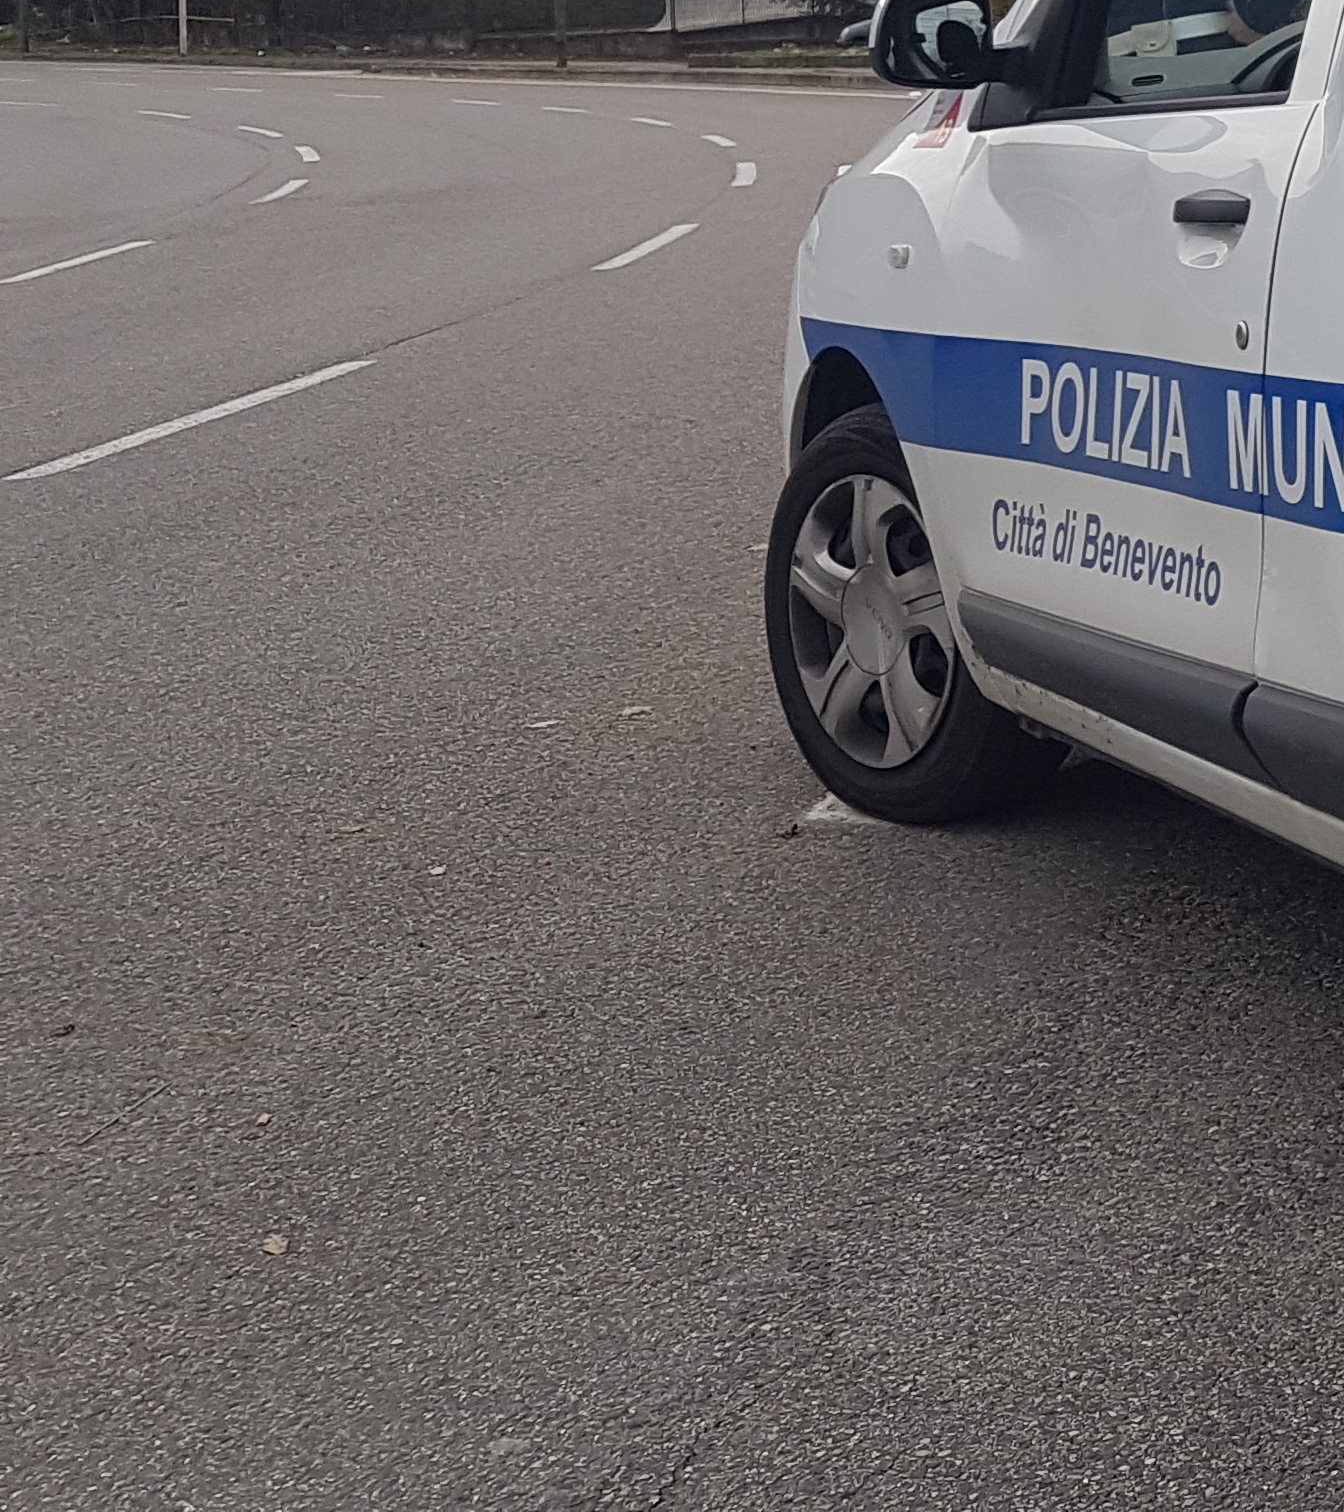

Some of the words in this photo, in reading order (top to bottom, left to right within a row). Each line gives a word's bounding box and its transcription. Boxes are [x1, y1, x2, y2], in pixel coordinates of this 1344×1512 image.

[1020, 358, 1192, 480] POLIZIA
[991, 498, 1046, 561] Città
[1051, 508, 1078, 562] di
[1080, 514, 1223, 608] Benevento
